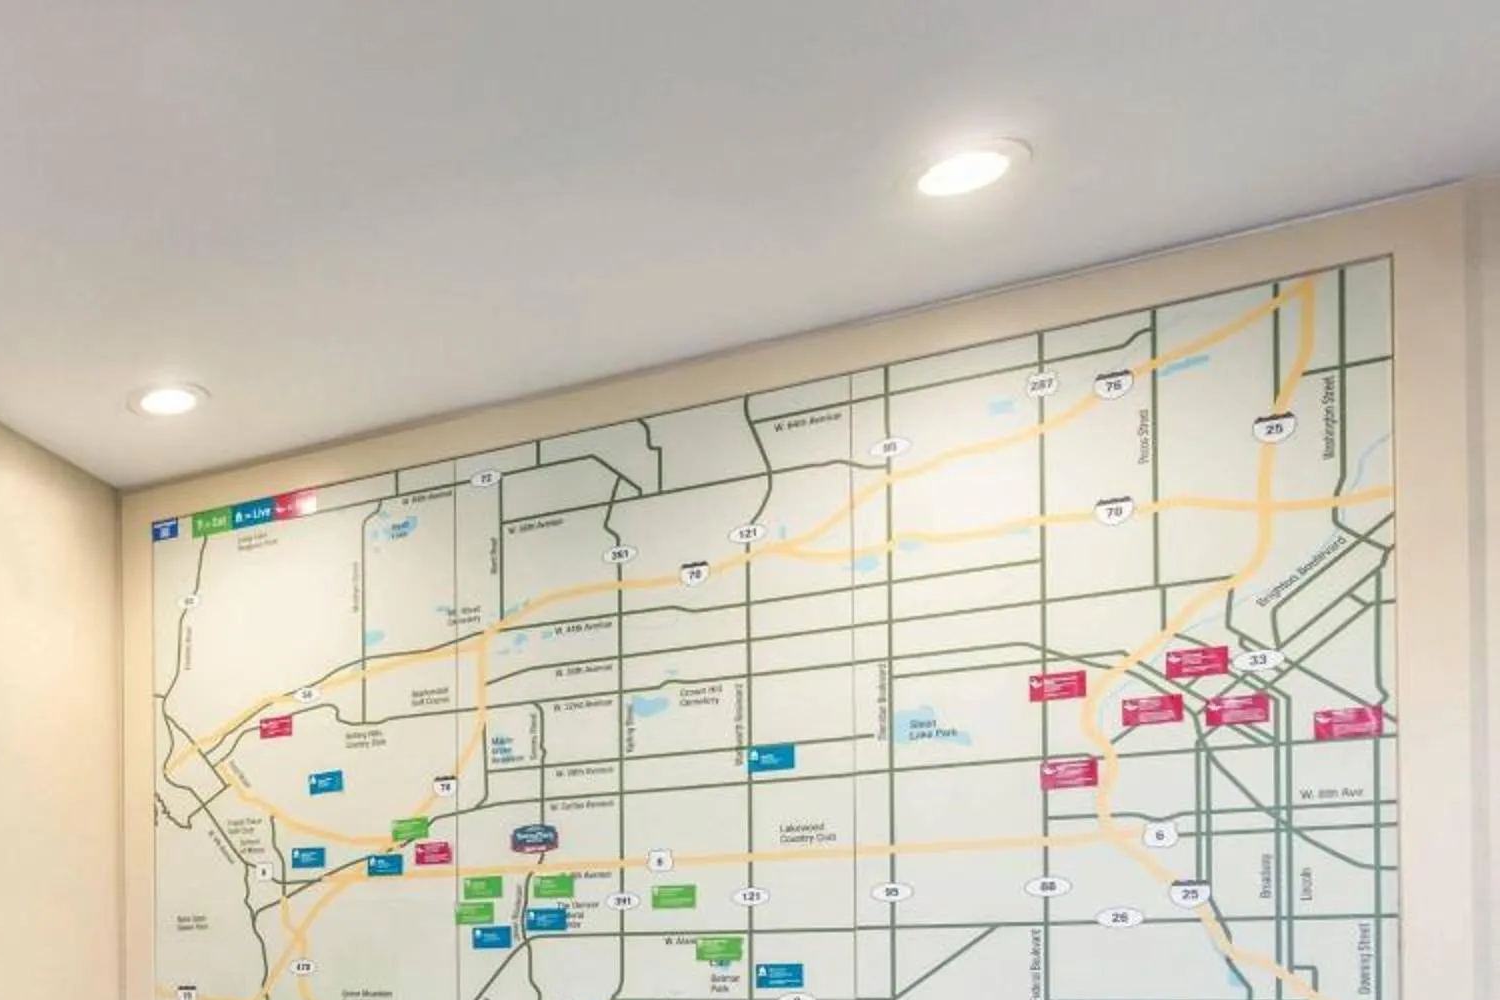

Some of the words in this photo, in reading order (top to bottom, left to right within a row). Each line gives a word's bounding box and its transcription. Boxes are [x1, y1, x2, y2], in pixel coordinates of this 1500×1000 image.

[1266, 424, 1283, 434] 25
[252, 507, 272, 521] Live
[779, 823, 825, 833] Lakewood
[779, 834, 814, 844] Country
[743, 892, 761, 902] 121
[1182, 888, 1199, 899] 25
